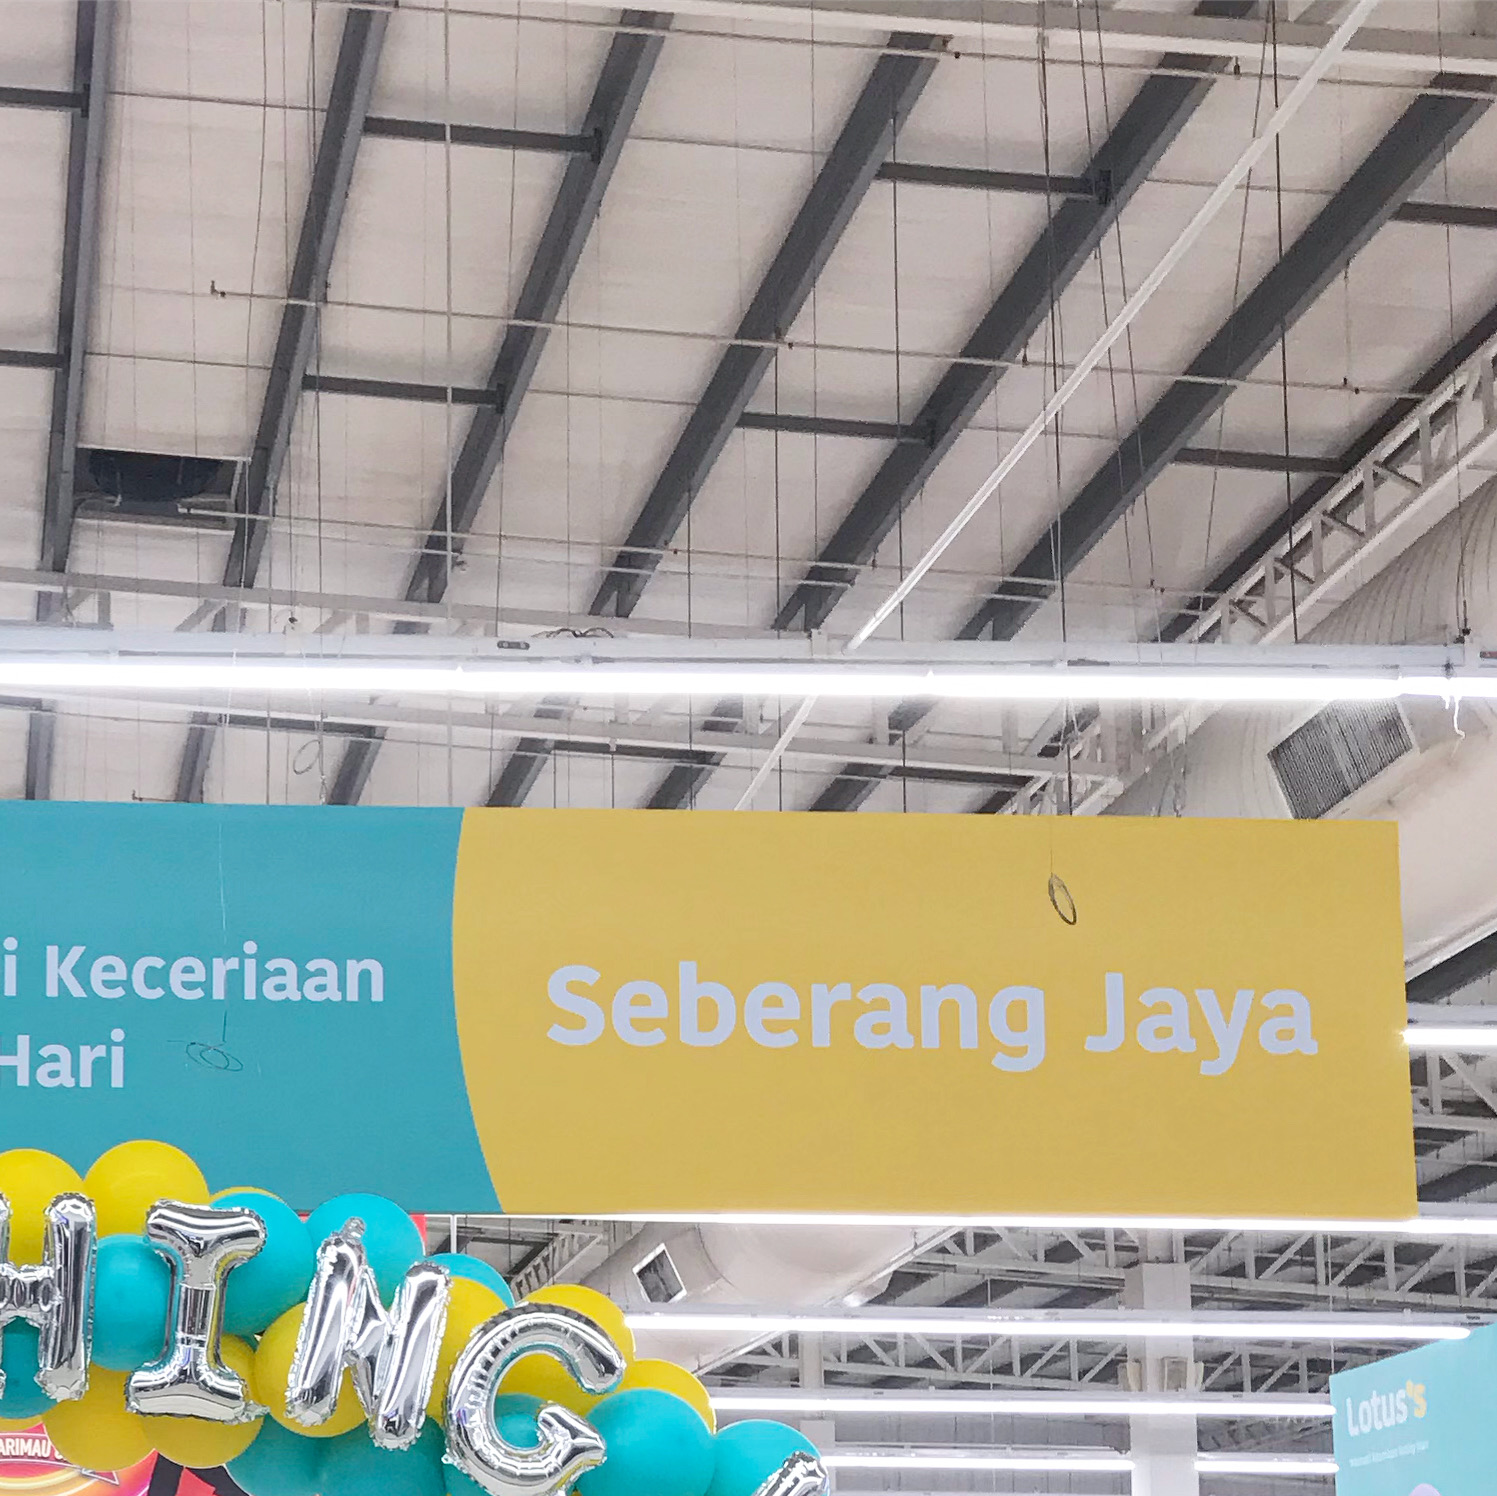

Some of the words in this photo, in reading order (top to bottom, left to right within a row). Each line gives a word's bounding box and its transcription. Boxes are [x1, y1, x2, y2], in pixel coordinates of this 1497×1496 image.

[44, 941, 385, 1006] Keceriaan
[546, 962, 1047, 1072] Seberang
[1083, 972, 1319, 1078] Jaya
[1346, 1379, 1428, 1438] Lotus's
